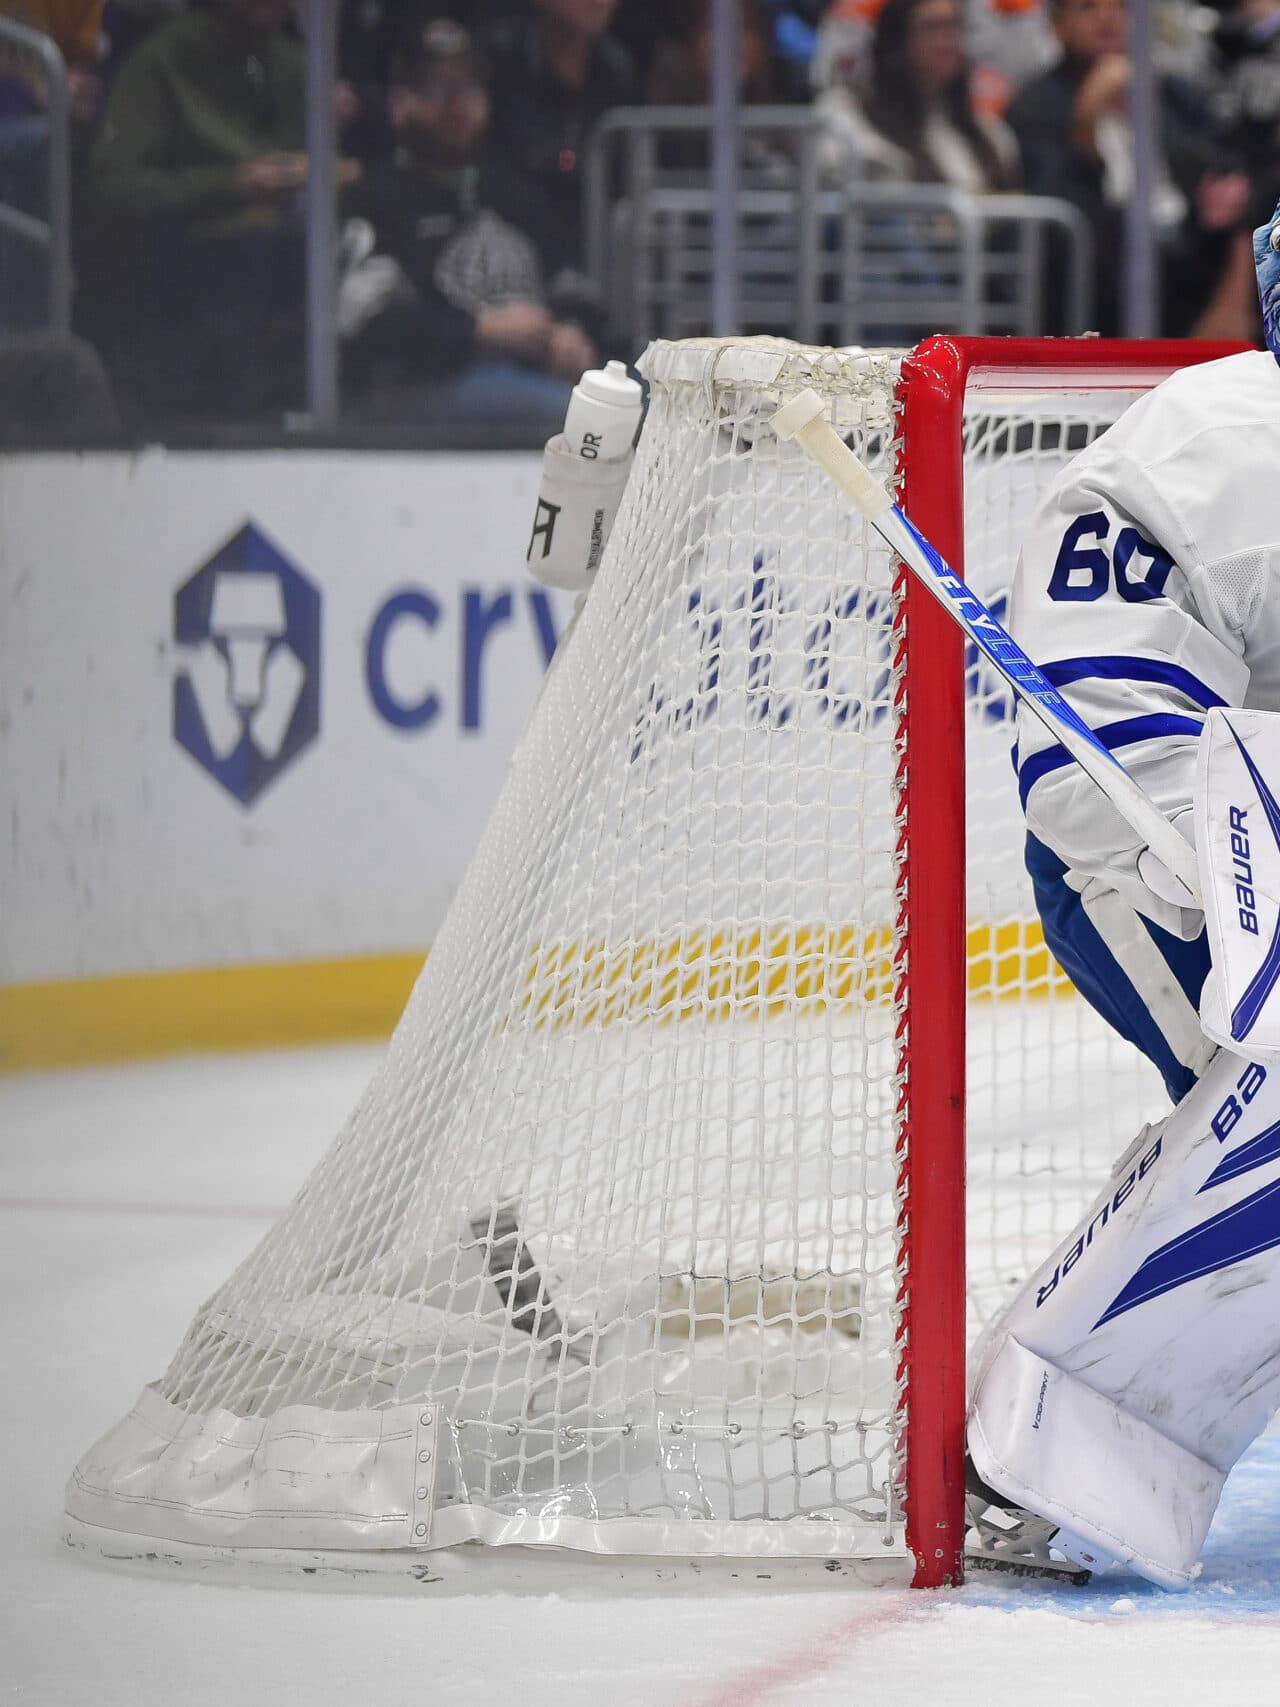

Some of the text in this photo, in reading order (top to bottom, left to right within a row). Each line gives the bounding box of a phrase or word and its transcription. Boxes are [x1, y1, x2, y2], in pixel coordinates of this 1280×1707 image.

[1047, 511, 1176, 603] 60
[1229, 805, 1259, 936] BAUER
[1036, 1134, 1164, 1309] BAUER
